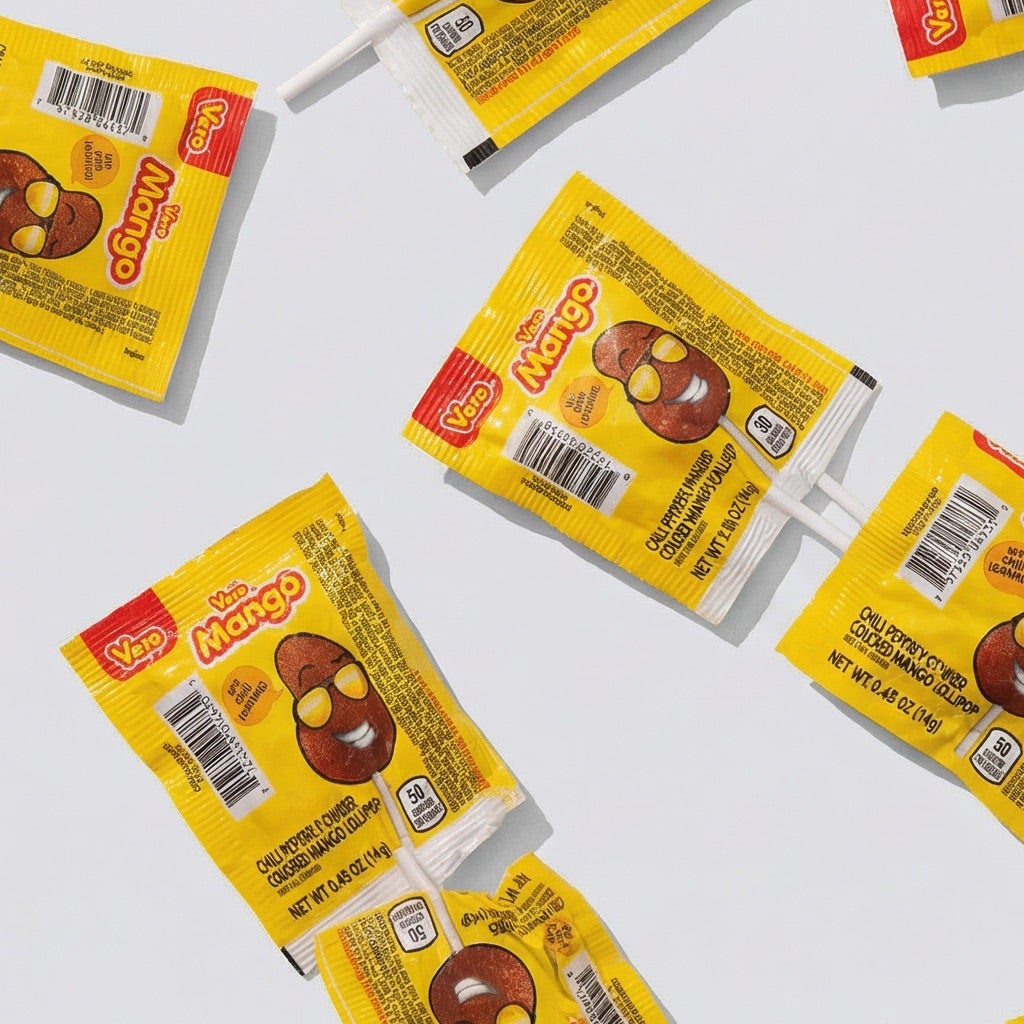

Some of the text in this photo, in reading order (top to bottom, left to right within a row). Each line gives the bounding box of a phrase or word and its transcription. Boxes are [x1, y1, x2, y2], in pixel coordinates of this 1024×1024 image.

[110, 159, 173, 283] Mango
[514, 280, 596, 391] Mango
[753, 414, 773, 434] 30
[689, 499, 747, 582] NET WT OZ
[194, 573, 303, 662] Mango
[110, 631, 162, 665] Vero
[889, 648, 936, 688] MANGO
[826, 648, 855, 674] NET
[896, 695, 917, 716] OZ
[910, 704, 944, 736] (14g)
[992, 736, 1013, 758] 50
[405, 783, 426, 805] 50
[287, 894, 313, 921] NET
[307, 882, 331, 906] WT
[348, 857, 369, 877] OZ
[362, 841, 393, 869] (14g)
[407, 924, 428, 943] 50
